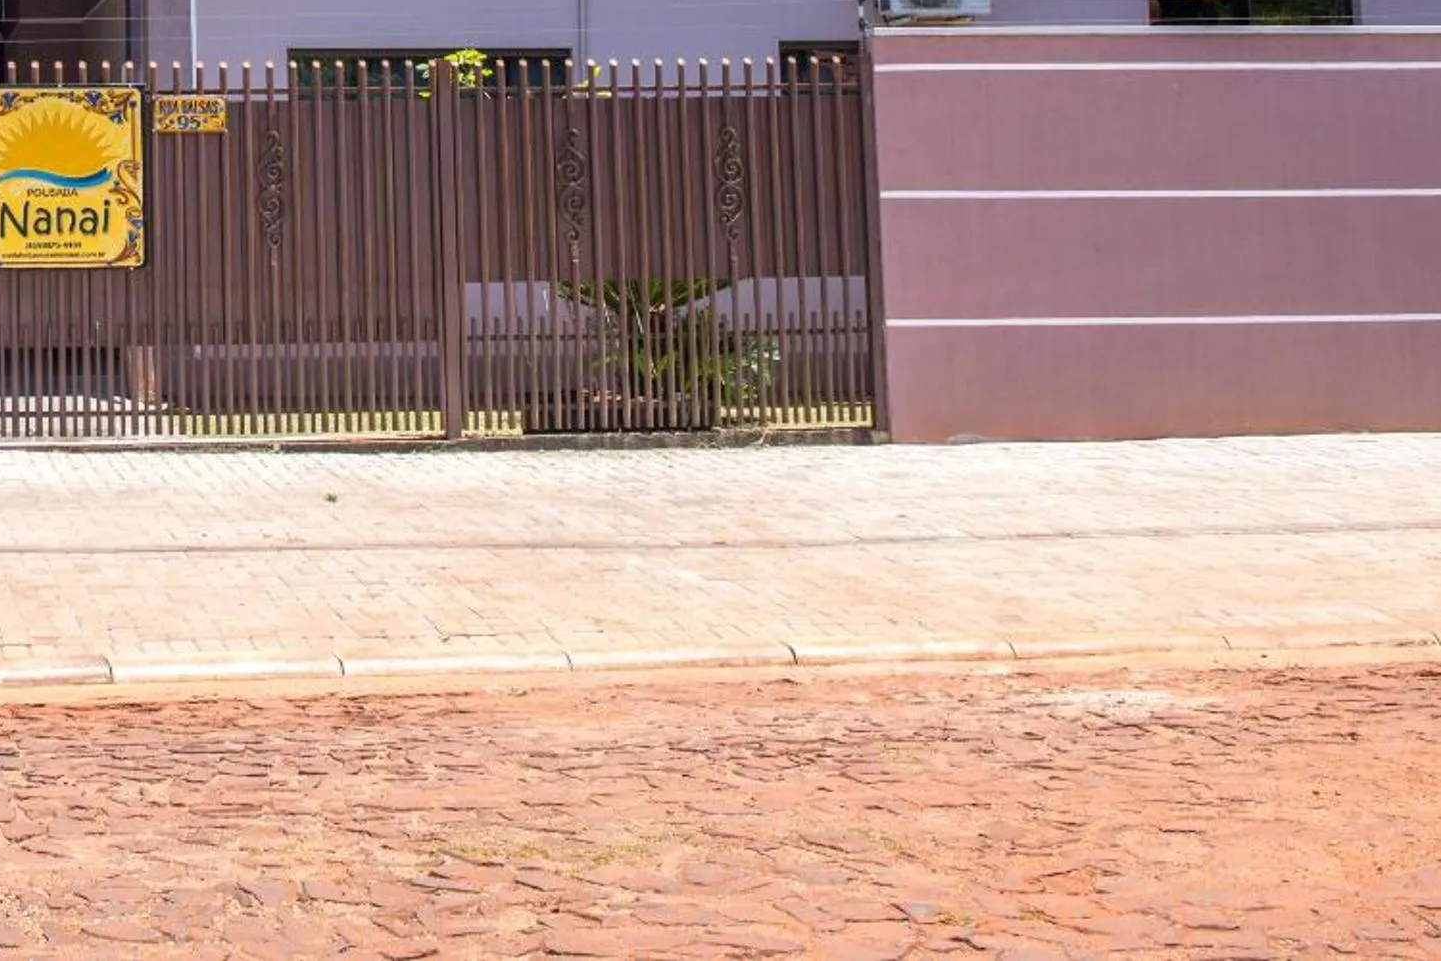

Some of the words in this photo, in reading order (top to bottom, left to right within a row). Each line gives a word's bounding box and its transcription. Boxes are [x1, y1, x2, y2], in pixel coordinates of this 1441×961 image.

[177, 115, 201, 129] 95
[27, 188, 78, 197] POUSADA
[0, 199, 110, 237] Nanai
